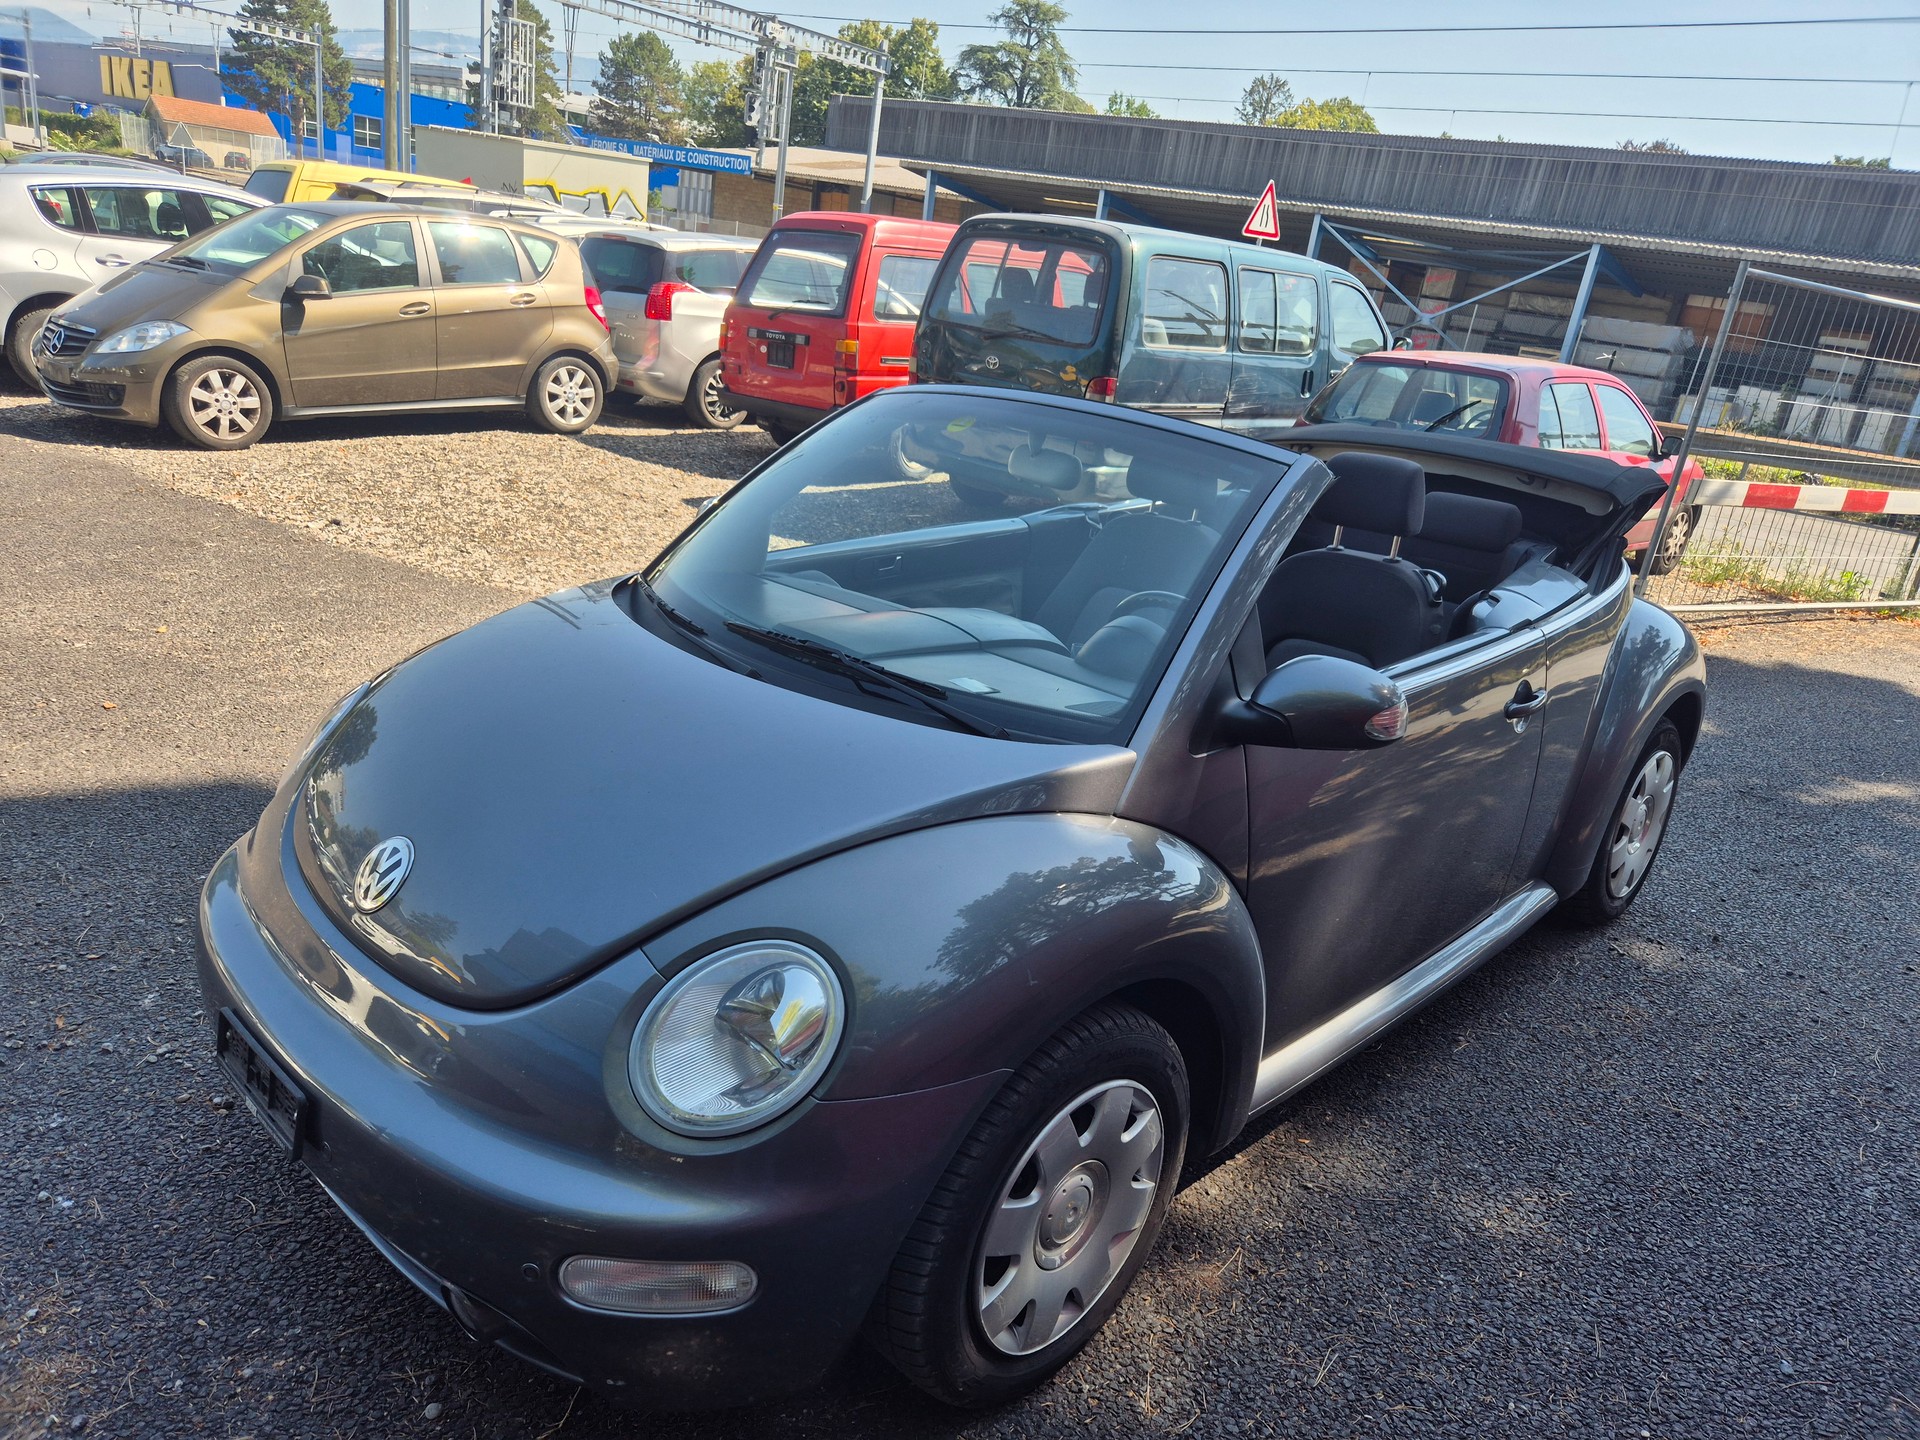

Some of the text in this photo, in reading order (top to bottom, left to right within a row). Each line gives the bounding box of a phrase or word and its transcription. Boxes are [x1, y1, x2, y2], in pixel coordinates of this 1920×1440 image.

[100, 55, 175, 100] IKEA
[618, 143, 628, 154] SA
[633, 144, 675, 160] MATÉRIAUX
[675, 151, 686, 162] DE
[687, 151, 749, 170] CONSTRUCTION
[766, 332, 785, 340] TOYOTA
